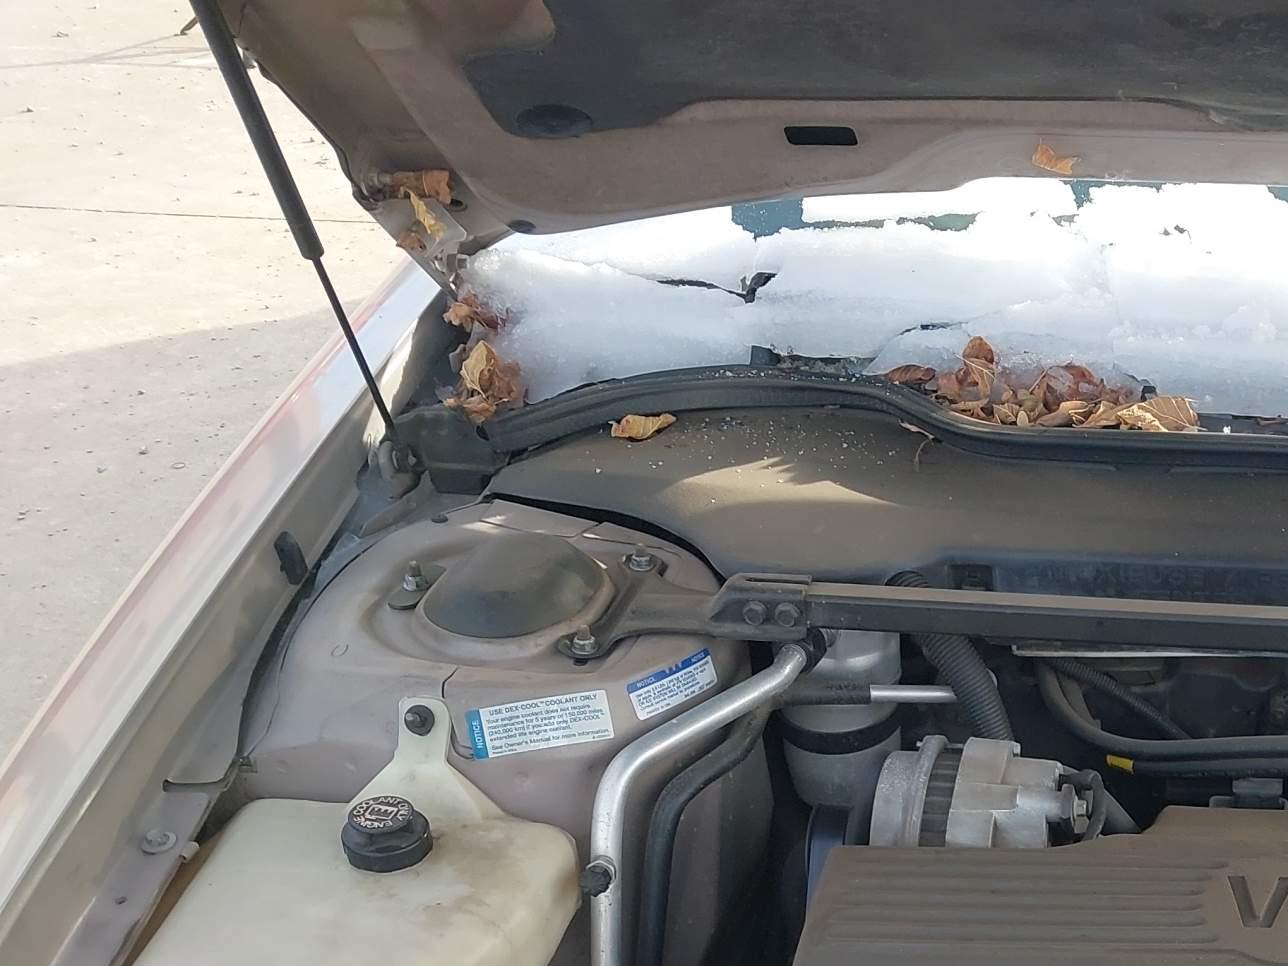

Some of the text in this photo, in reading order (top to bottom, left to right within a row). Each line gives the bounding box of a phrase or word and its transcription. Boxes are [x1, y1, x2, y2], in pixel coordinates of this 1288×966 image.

[488, 706, 503, 716] USE
[544, 696, 577, 706] COOLANT
[579, 693, 597, 701] ONLY
[500, 714, 520, 722] engine
[472, 720, 484, 749] NOTICE
[353, 797, 404, 816] COOLANT
